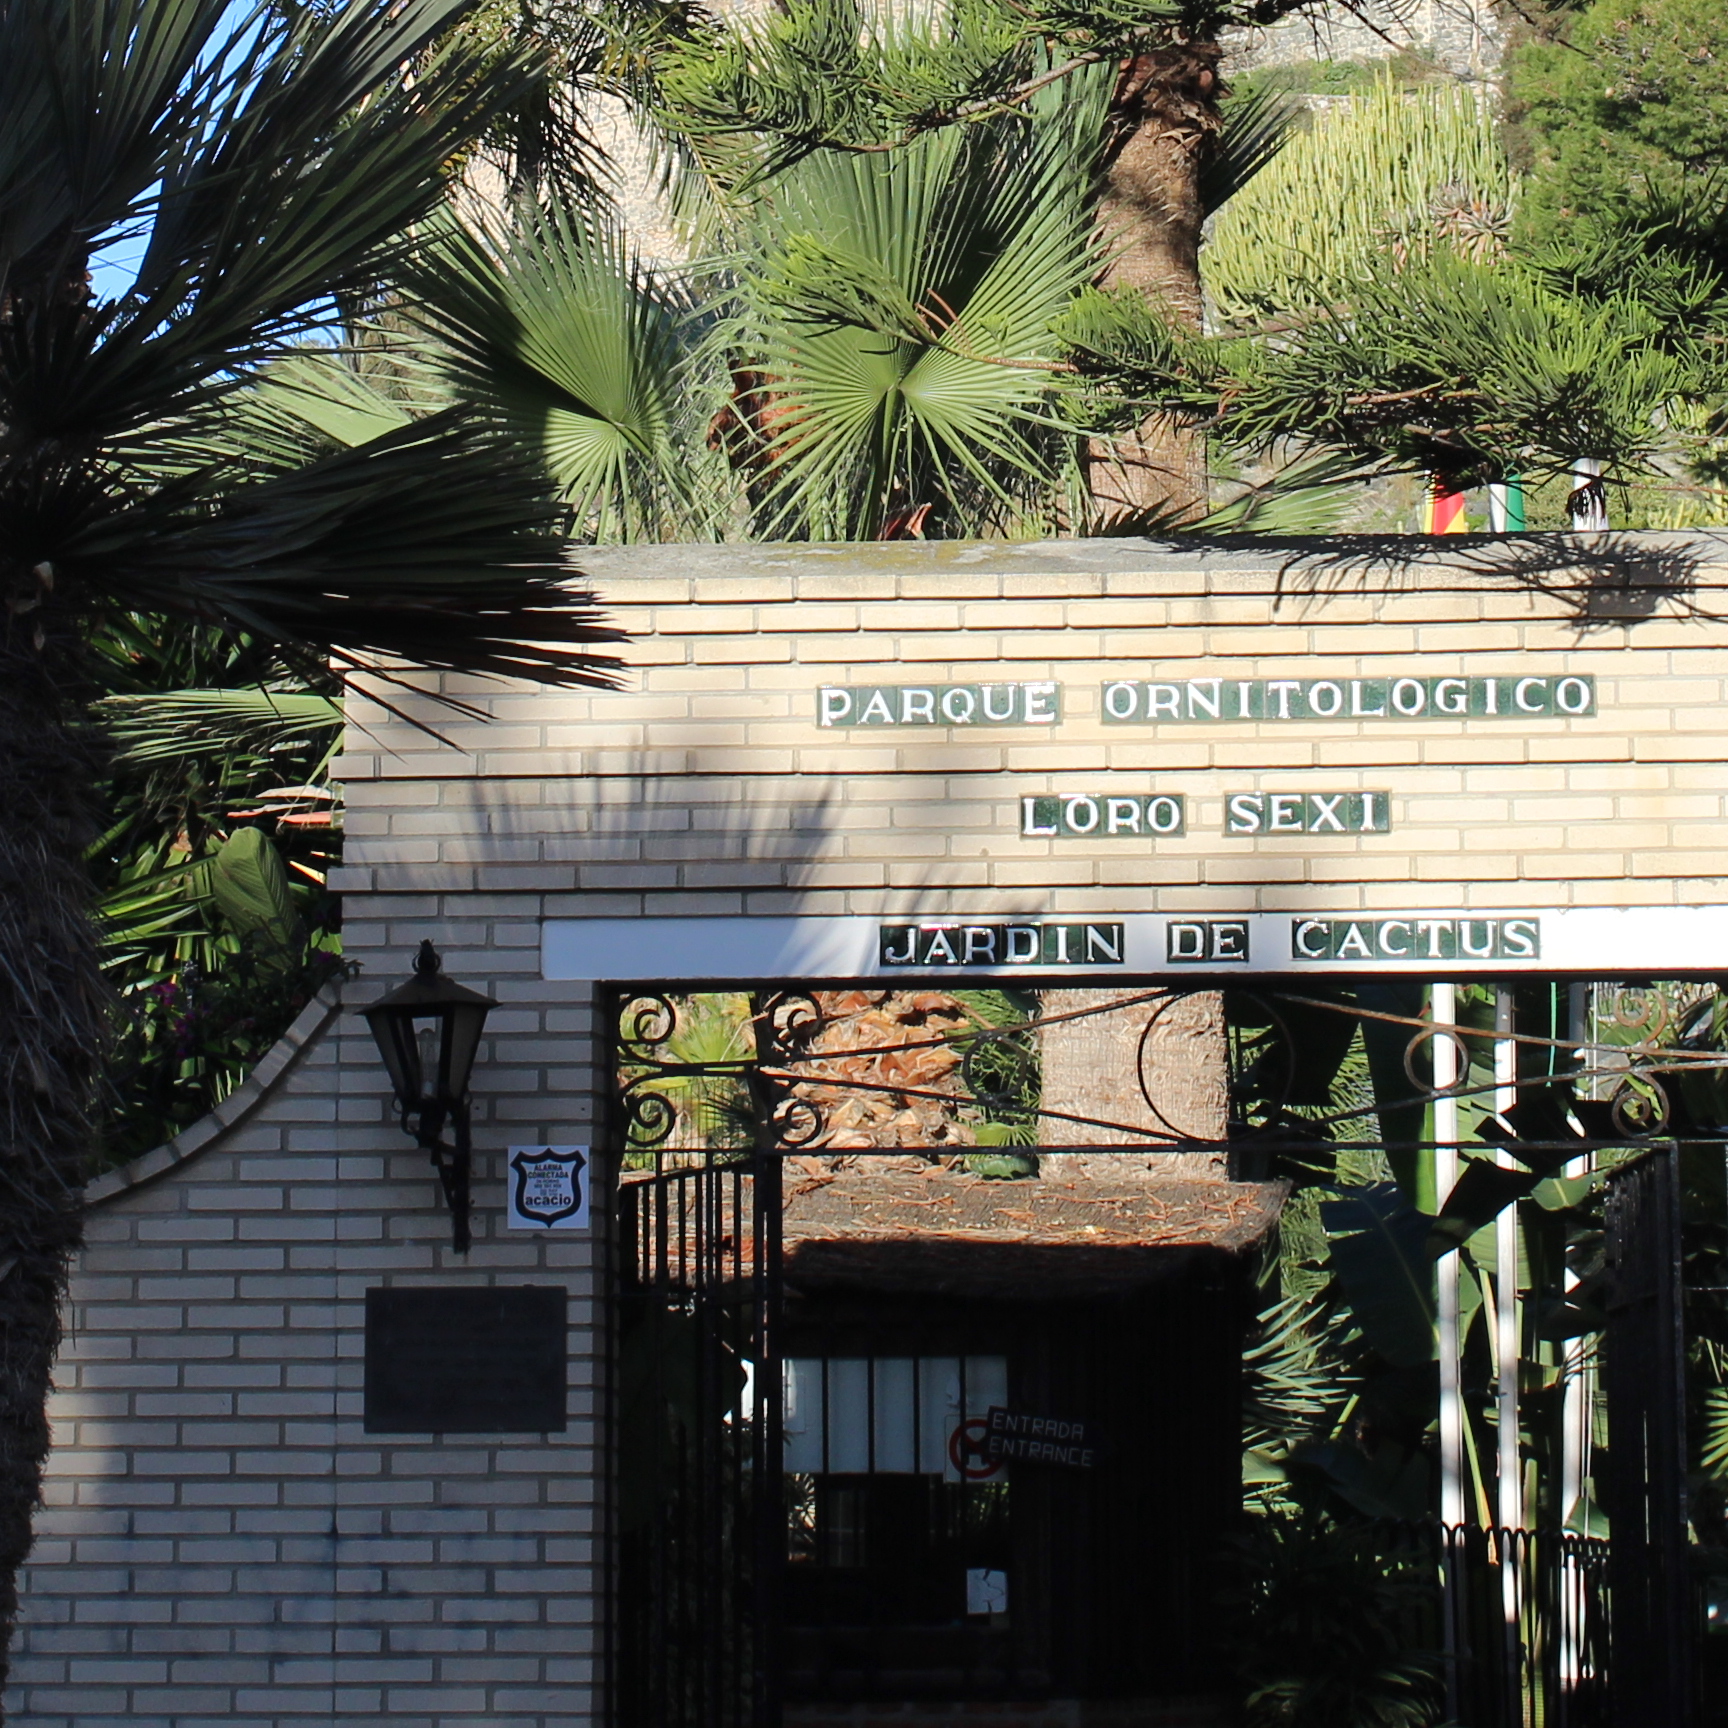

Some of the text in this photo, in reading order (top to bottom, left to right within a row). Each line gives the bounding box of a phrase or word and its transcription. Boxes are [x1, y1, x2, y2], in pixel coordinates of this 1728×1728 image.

[820, 676, 1591, 727] PARQUE ORNITOLOGICO
[1022, 793, 1376, 835] LORO SEXI
[884, 919, 1538, 964] JARDIN DE CACTUS
[525, 1193, 572, 1206] acacio
[992, 1412, 1084, 1441] ENTRADA
[989, 1436, 1094, 1467] ENTRANCE
